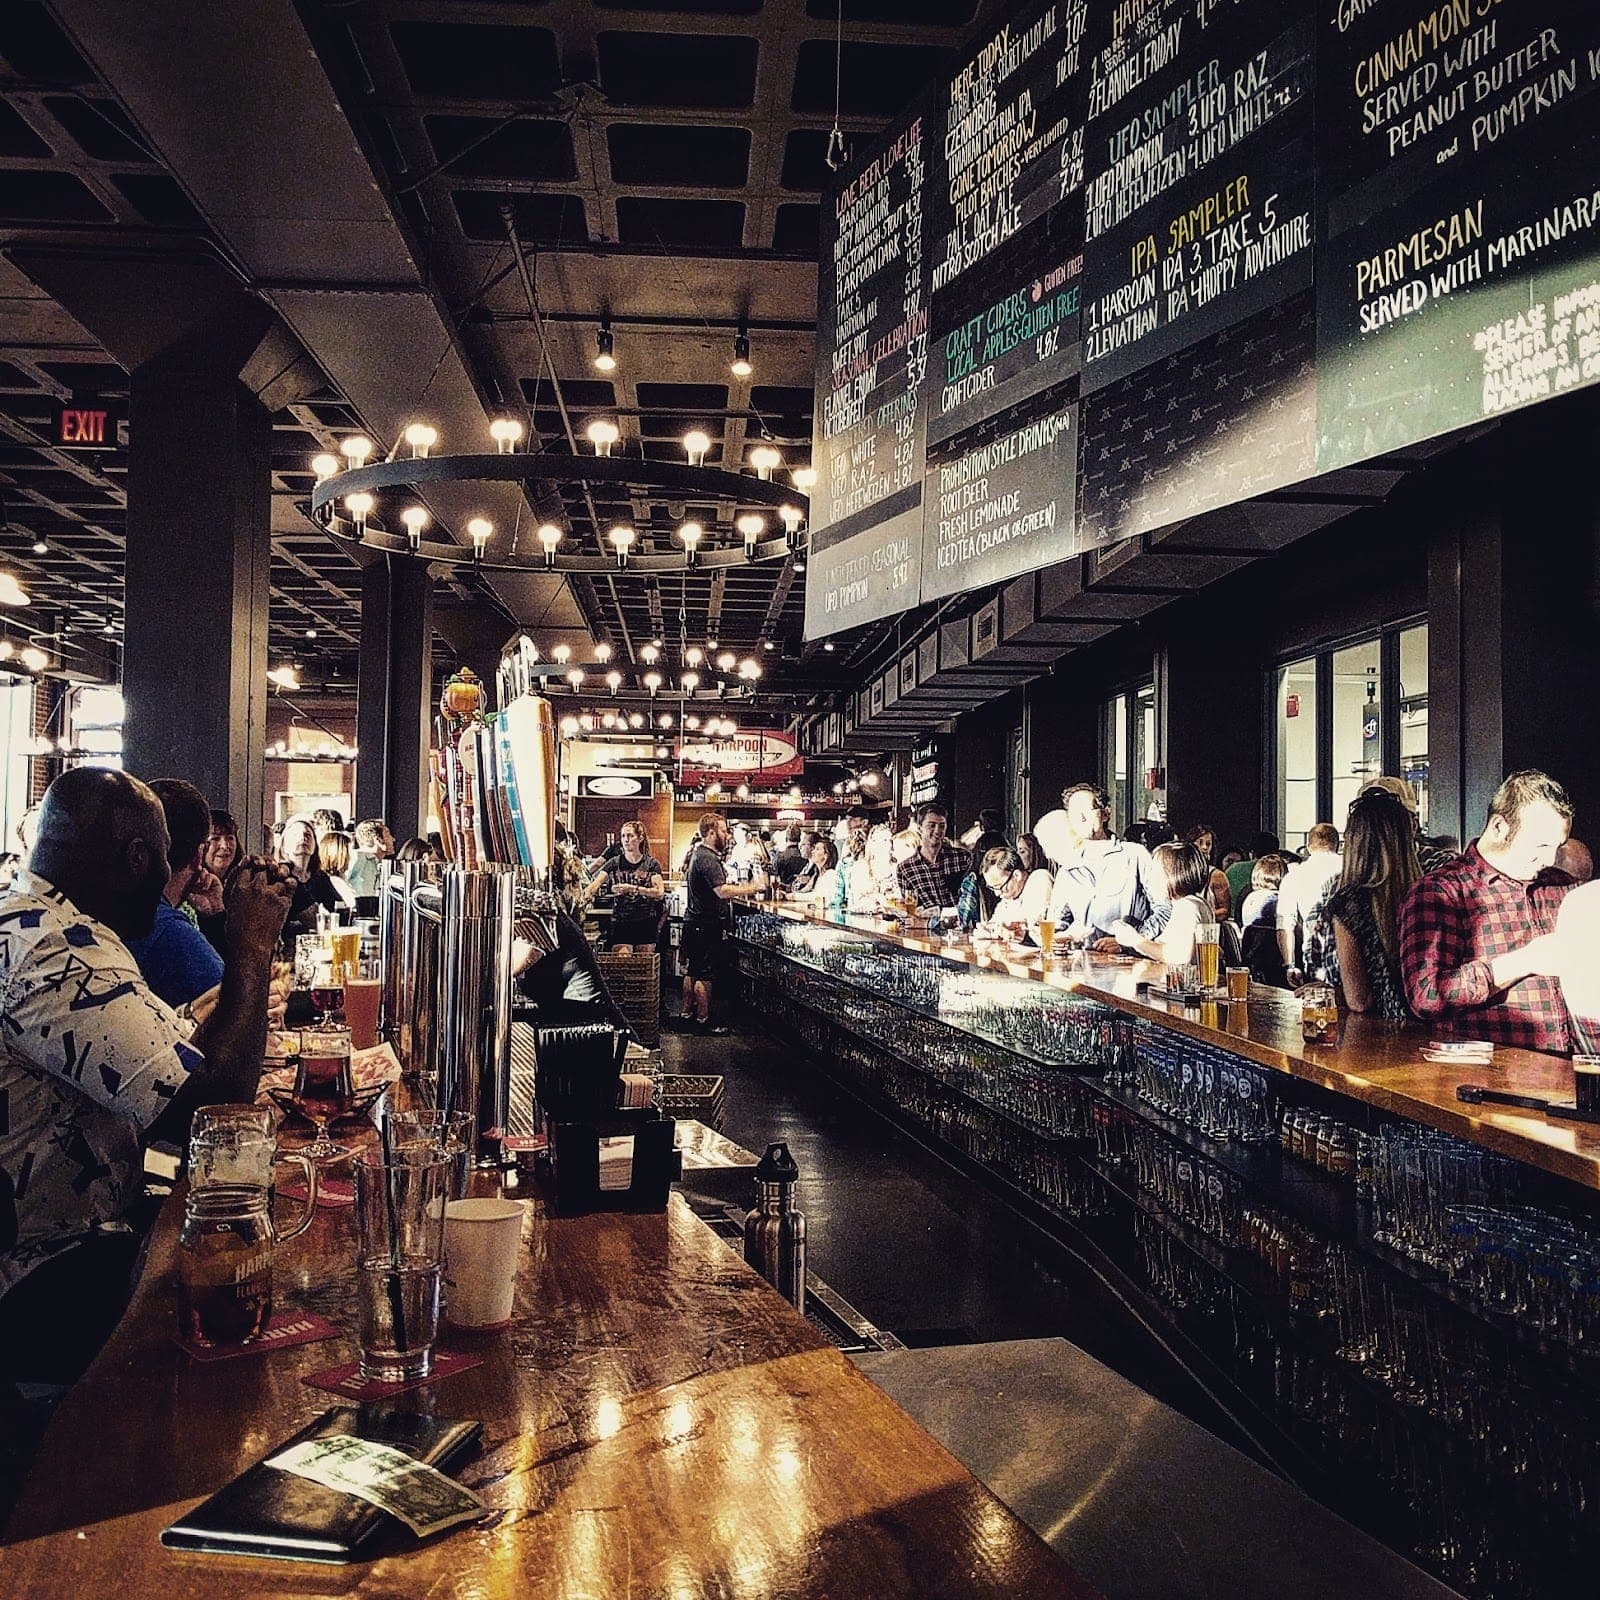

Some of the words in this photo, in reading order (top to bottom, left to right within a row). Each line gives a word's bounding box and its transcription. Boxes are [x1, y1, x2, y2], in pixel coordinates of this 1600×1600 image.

[950, 60, 975, 105] HERE
[1043, 5, 1056, 42] ALE
[1056, 44, 1080, 88] 10.0%
[1097, 52, 1143, 112] FLANNEL
[1143, 17, 1182, 81] FRIDAY
[1355, 0, 1471, 97] CINNAMON
[1362, 61, 1438, 134] SERVED
[1444, 19, 1497, 78] WITH
[945, 90, 997, 160] CZERNOBOG
[982, 102, 1016, 151] IMPERIAL
[1018, 88, 1032, 121] IPA
[1095, 168, 1115, 207] UFO
[1115, 132, 1163, 194] PUMPKIN
[1201, 83, 1226, 129] UFO
[1234, 51, 1268, 106] RAZ
[1108, 118, 1140, 165] UFO
[1142, 59, 1220, 140] SAMPLER
[1386, 81, 1468, 157] PEANUT
[1473, 28, 1561, 103] BUTTER
[1436, 137, 1459, 164] and
[1472, 58, 1576, 151] PUMPKIN
[836, 180, 858, 219] LOVE
[859, 159, 881, 197] BEER
[883, 134, 904, 175] LOVE
[905, 116, 923, 151] LIFE
[949, 163, 975, 205] GONE
[976, 109, 1036, 182] TOMORROW
[955, 187, 979, 226] PILOT
[1042, 117, 1068, 149] LIMITED
[1093, 199, 1112, 237] UFO
[1115, 145, 1186, 224] HEFEWEIZEN
[1202, 119, 1226, 164] UFO
[1229, 83, 1274, 144] WHITE
[837, 241, 864, 283] BOSTON
[881, 204, 904, 239] STOUT
[840, 186, 875, 236] HARPOON
[932, 251, 962, 293] NITRO
[963, 221, 999, 269] SCOTCH
[1000, 205, 1022, 241] ALE
[946, 220, 967, 259] PALE
[973, 202, 991, 238] OAT
[995, 183, 1014, 221] ALE
[1131, 235, 1157, 277] IPA
[1168, 176, 1250, 255] SAMPLER
[1356, 199, 1483, 301] PARMESAN
[837, 249, 877, 304] HARPOON
[878, 232, 900, 270] DARK
[1095, 300, 1158, 358] LEVIATHAN
[1167, 285, 1189, 323] IPA
[1203, 253, 1238, 303] HOPPY
[1244, 212, 1311, 281] ADVENTURE
[1101, 269, 1155, 326] HARPOON
[1162, 251, 1184, 291] IPA
[1205, 213, 1254, 264] TAKE
[1259, 193, 1279, 236] 5
[1359, 279, 1428, 334] SERVED
[1430, 249, 1482, 298] WITH
[1488, 190, 1600, 272] MARINARA
[837, 295, 854, 325] TAKE
[855, 290, 862, 311] 5
[872, 306, 928, 364] CELEBRATION
[945, 314, 985, 360] CRAFT
[986, 287, 1027, 334] CIDERS
[947, 347, 978, 383] LOCAL
[1056, 285, 1080, 321] FREE
[877, 386, 918, 430] OFFERINGS
[941, 379, 967, 413] CRAFT
[967, 365, 995, 399] CIDER
[1036, 325, 1060, 361] 4.8%
[61, 409, 107, 443] EXIT
[851, 434, 877, 468] WHITE
[940, 448, 990, 493] PROHIBITION
[990, 434, 1017, 470] STYLE
[1018, 413, 1056, 457] DRINKS
[831, 475, 847, 499] UFO
[939, 516, 968, 544] FRESH
[970, 490, 1020, 531] LEMONADE
[940, 491, 962, 518] ROOT
[962, 478, 989, 508] BEER
[957, 535, 976, 562] TEA
[976, 521, 1010, 557] (BLACK
[1021, 501, 1056, 536] GREEN)
[825, 590, 838, 613] UFO
